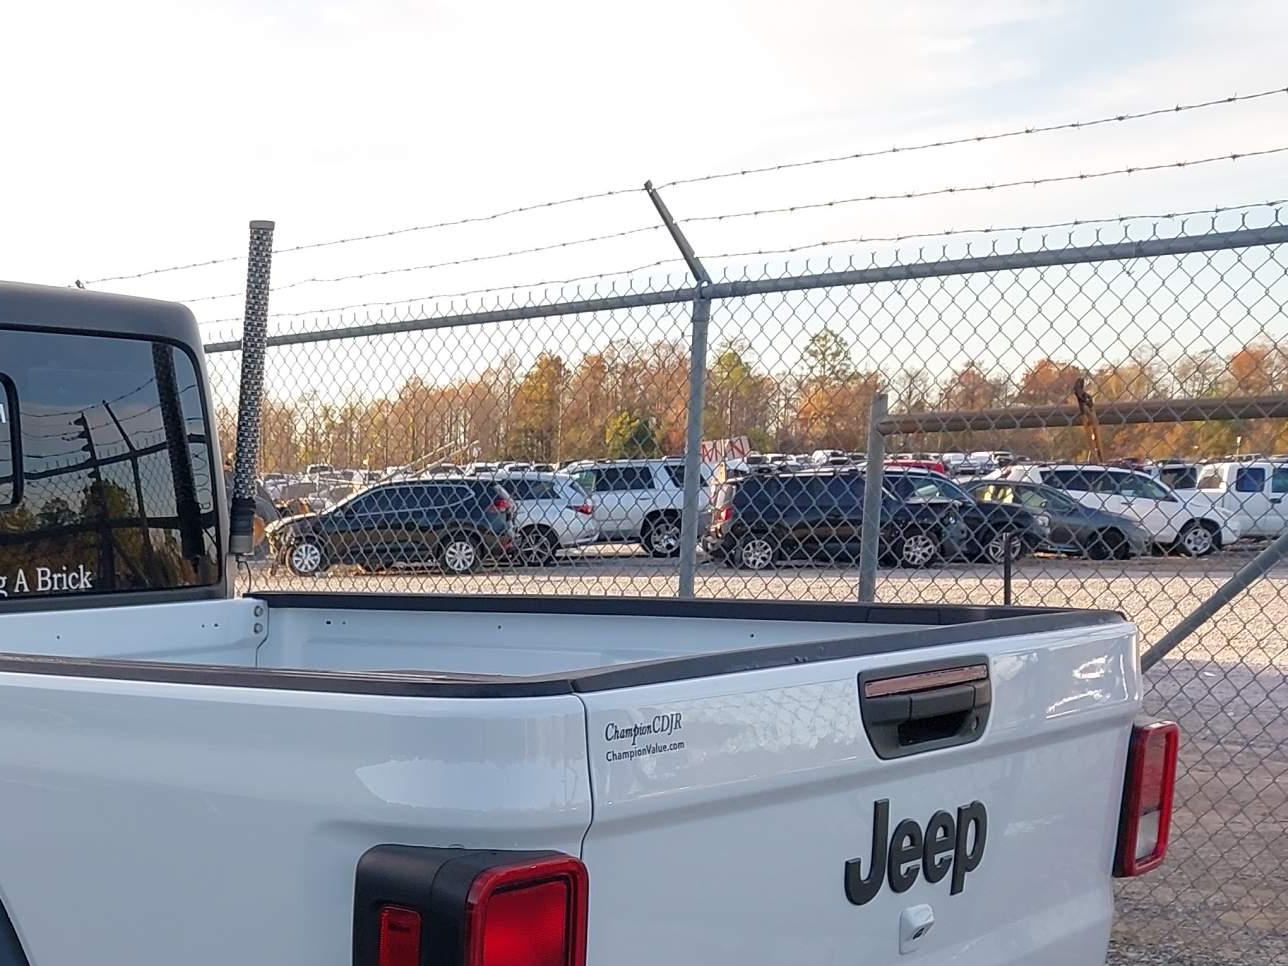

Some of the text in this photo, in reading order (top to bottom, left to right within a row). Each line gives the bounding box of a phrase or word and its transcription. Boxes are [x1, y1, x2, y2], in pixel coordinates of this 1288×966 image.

[14, 568, 30, 593] A
[36, 565, 93, 592] Brick
[605, 741, 685, 762] ChampionValue.com
[843, 798, 988, 907] Jeep
